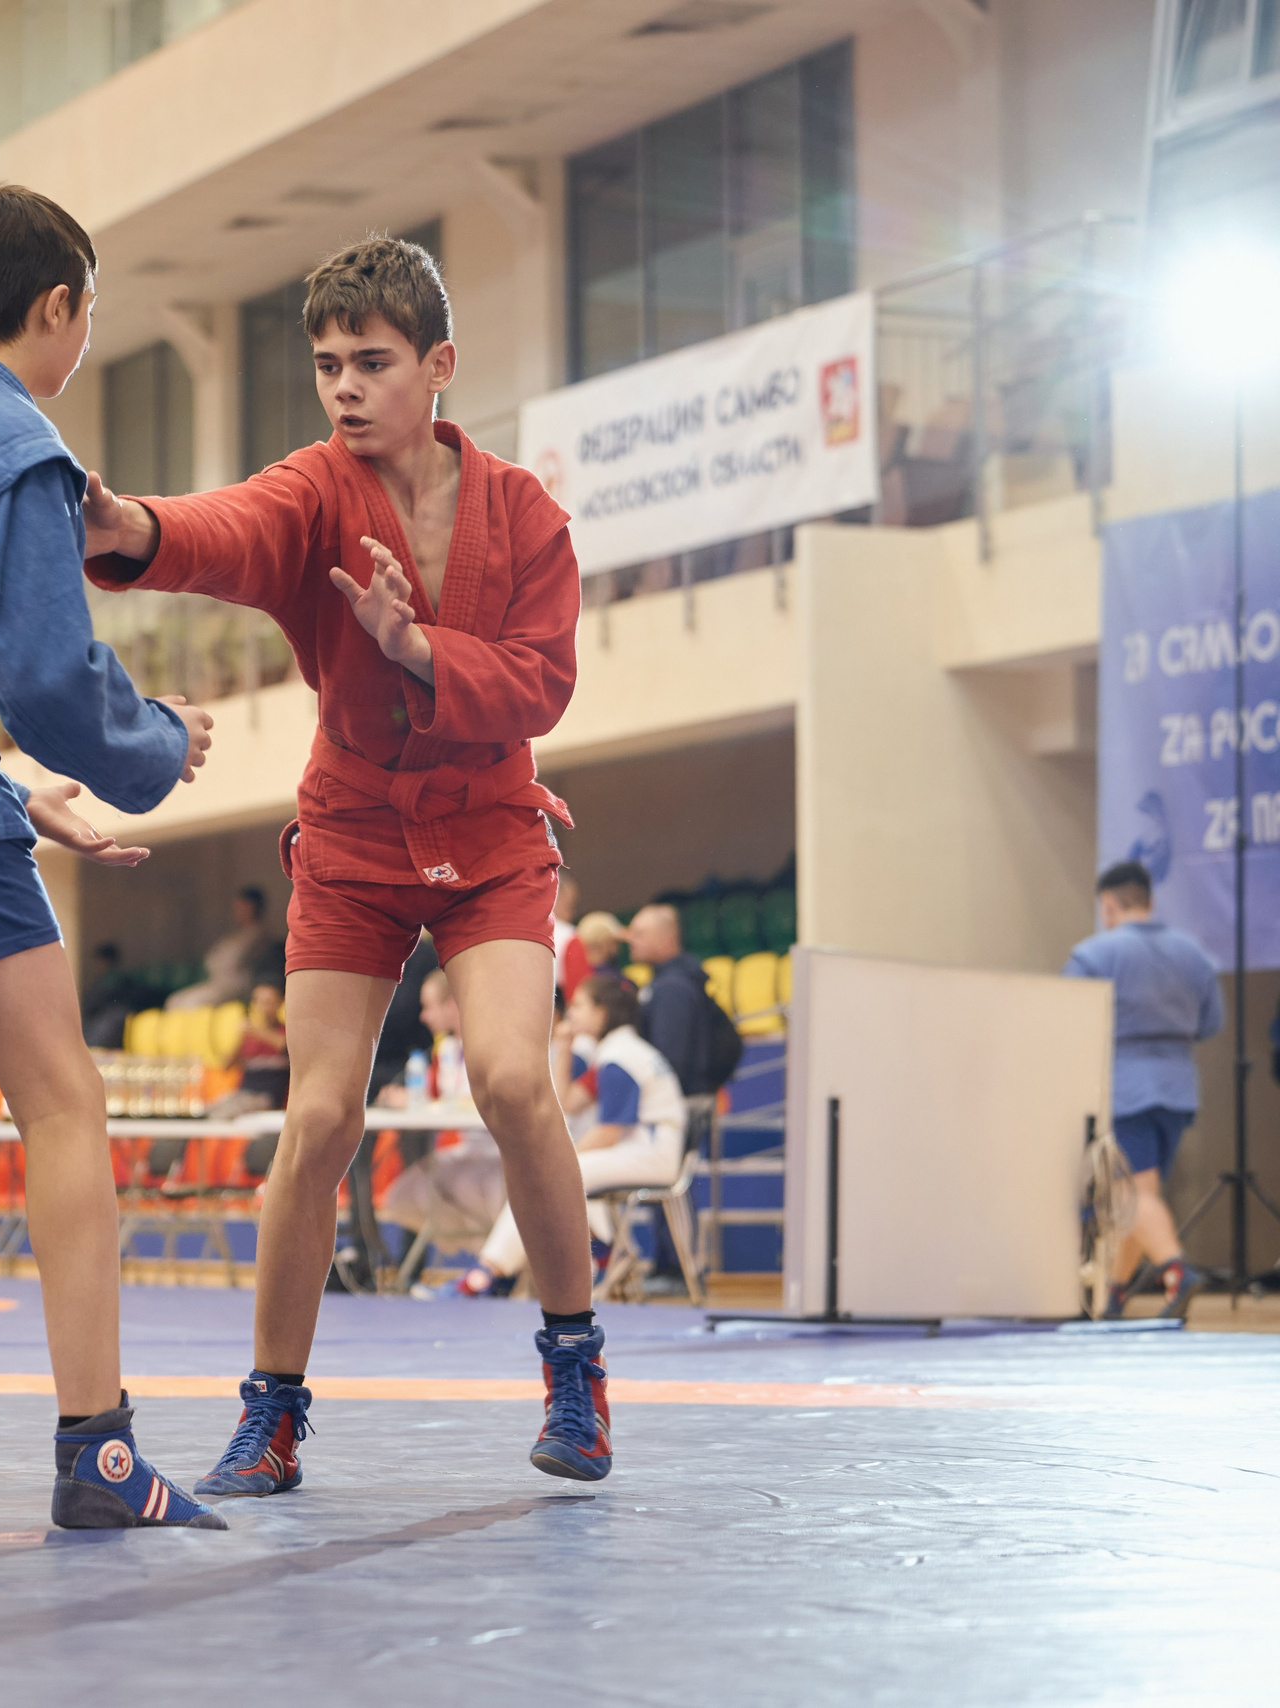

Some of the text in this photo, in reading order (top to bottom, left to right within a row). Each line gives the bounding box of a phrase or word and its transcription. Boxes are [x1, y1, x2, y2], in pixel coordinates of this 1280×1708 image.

[577, 367, 801, 464] ФЕДЕРАЦИЯ САМБО
[709, 435, 802, 486] ОБЛАСТИ
